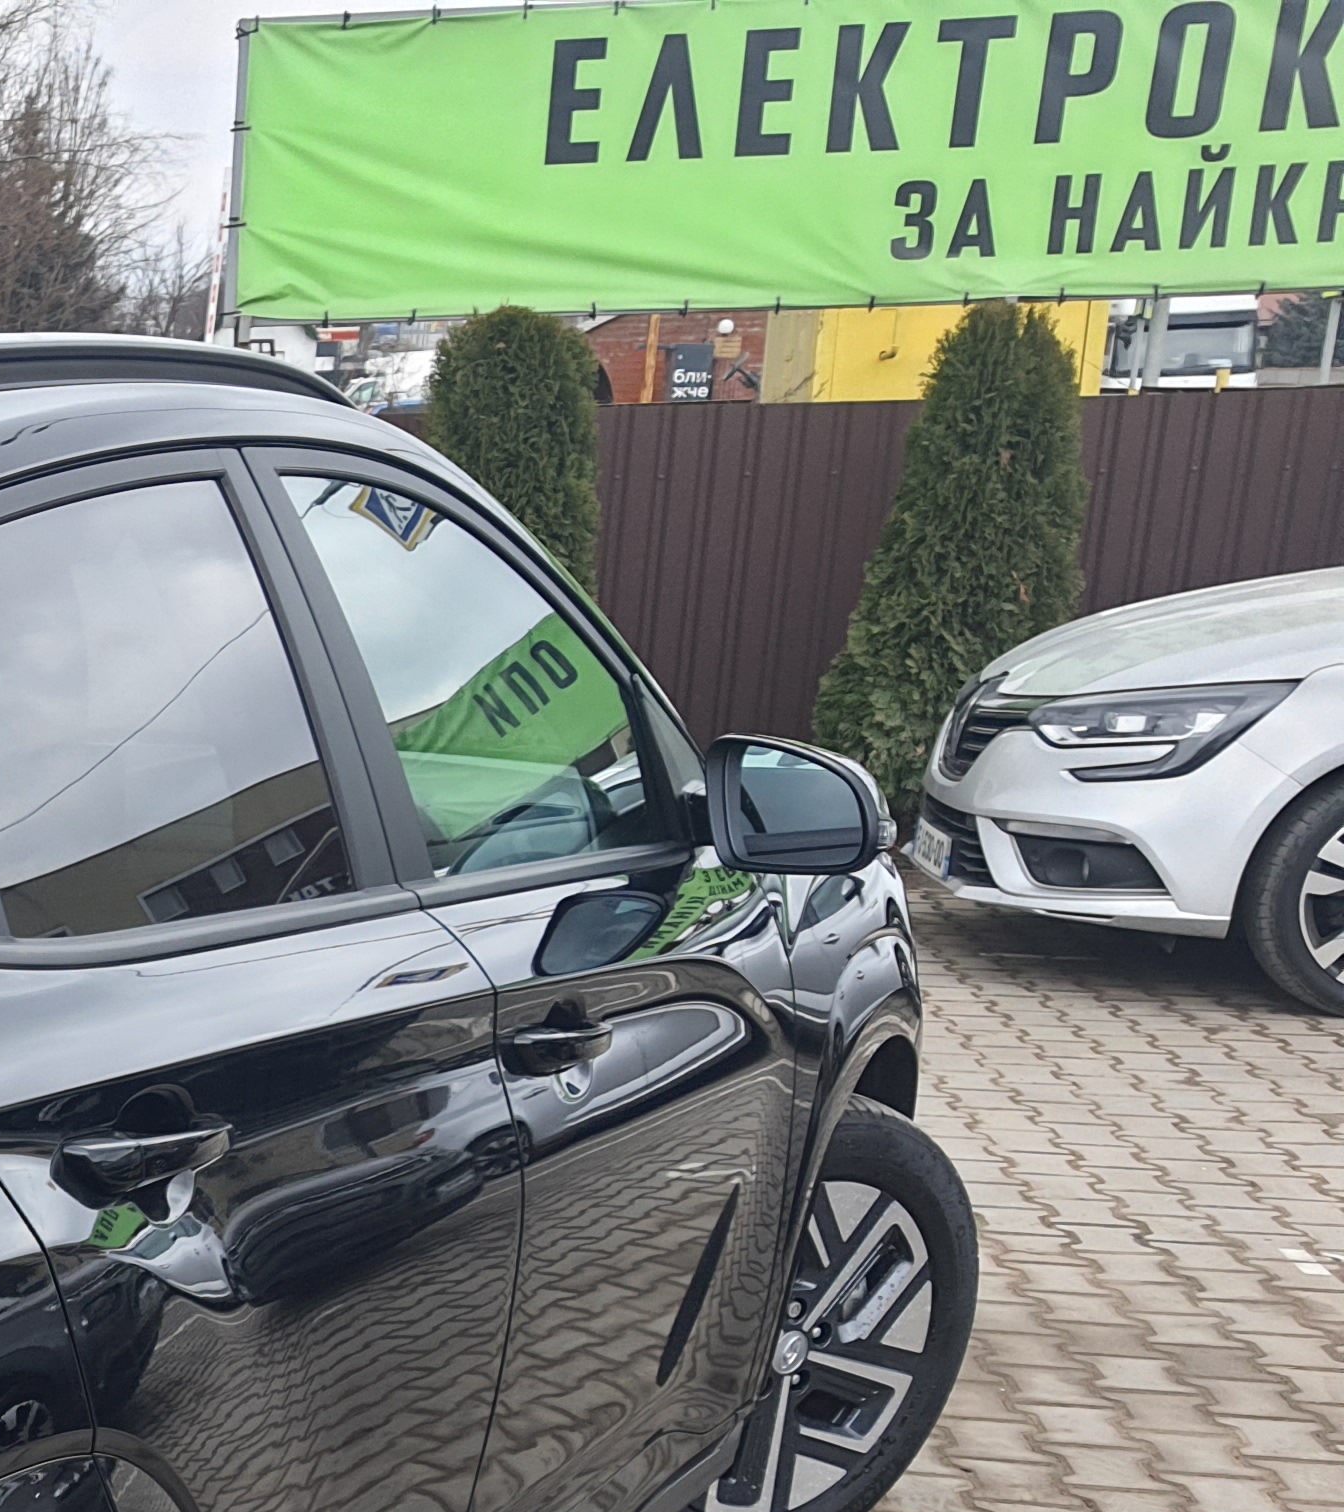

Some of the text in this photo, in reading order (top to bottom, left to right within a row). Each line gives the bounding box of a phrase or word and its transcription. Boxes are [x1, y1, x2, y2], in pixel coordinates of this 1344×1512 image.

[890, 179, 996, 261] ЗА
[673, 368, 712, 384] бли-
[671, 385, 709, 399] жче
